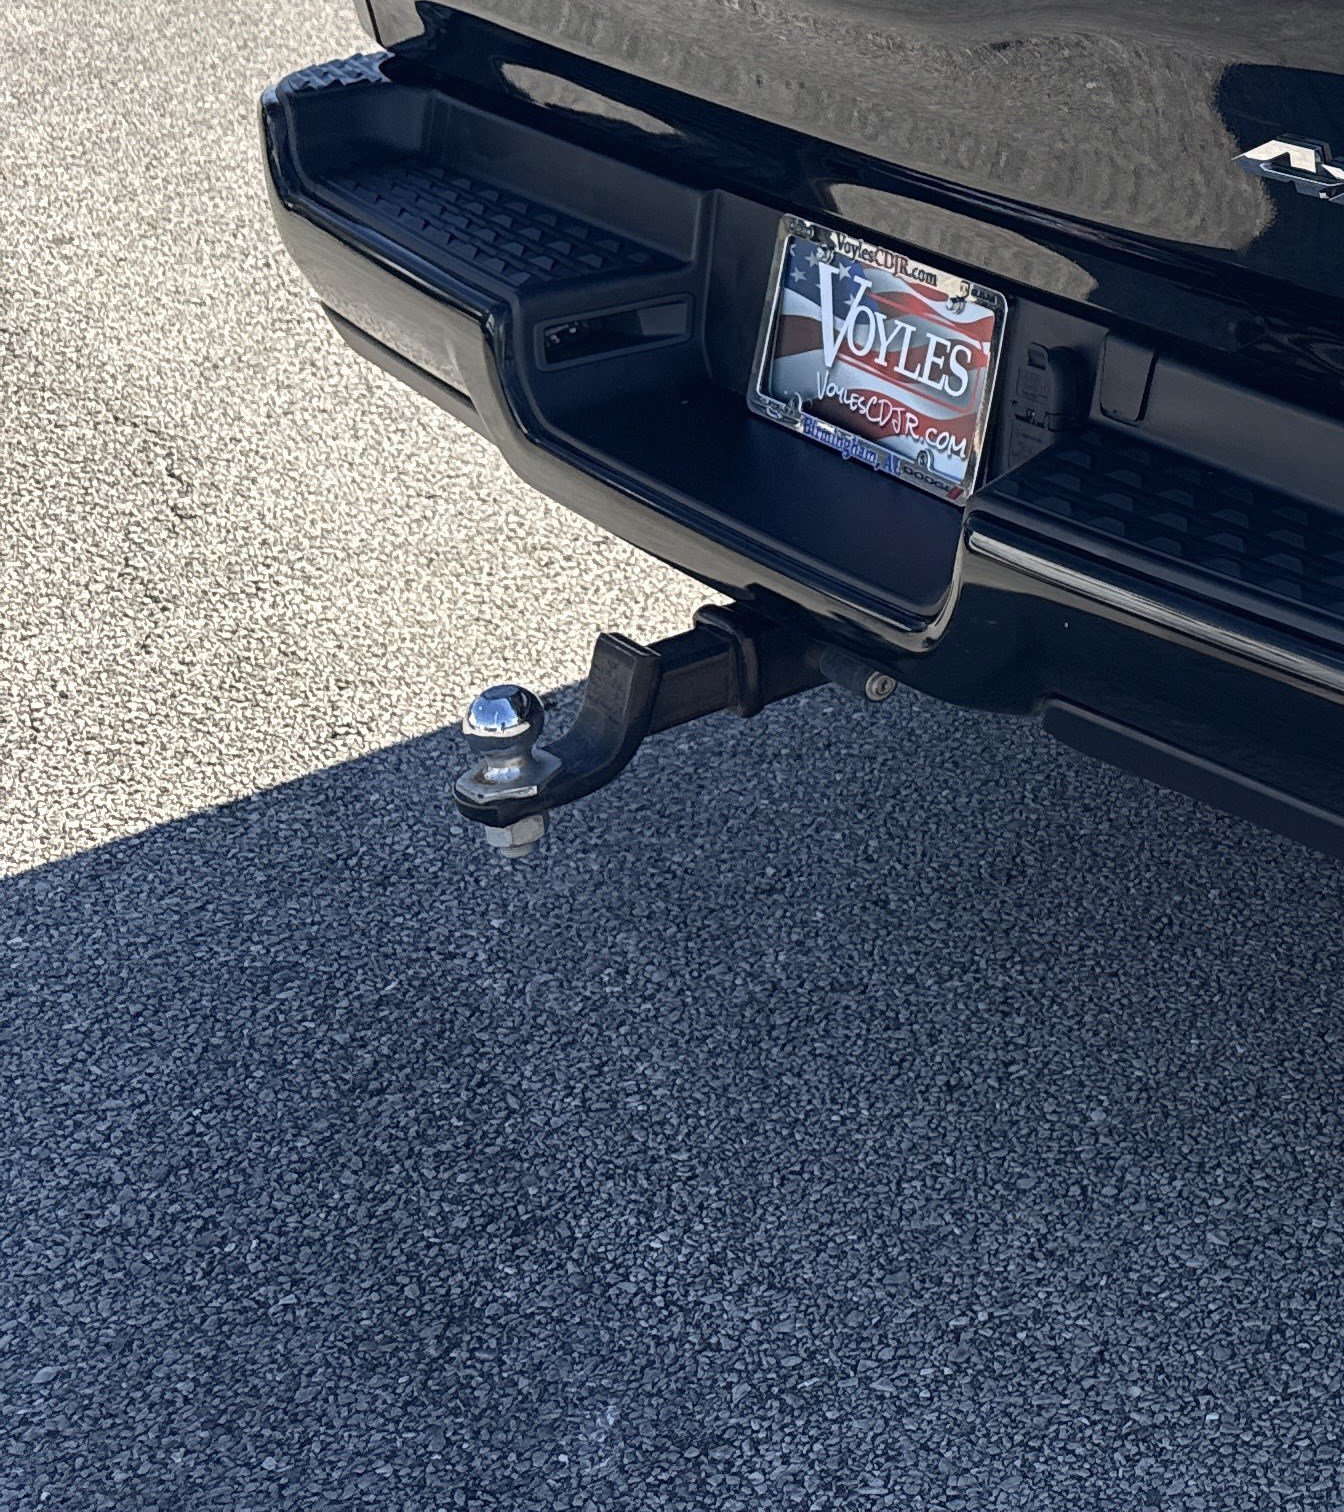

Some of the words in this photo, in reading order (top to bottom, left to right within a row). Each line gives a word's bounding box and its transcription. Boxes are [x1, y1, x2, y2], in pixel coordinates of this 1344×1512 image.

[835, 233, 938, 287] VoylesCDJR.com
[817, 262, 973, 397] VOYLES
[802, 415, 881, 472] Birmingham,
